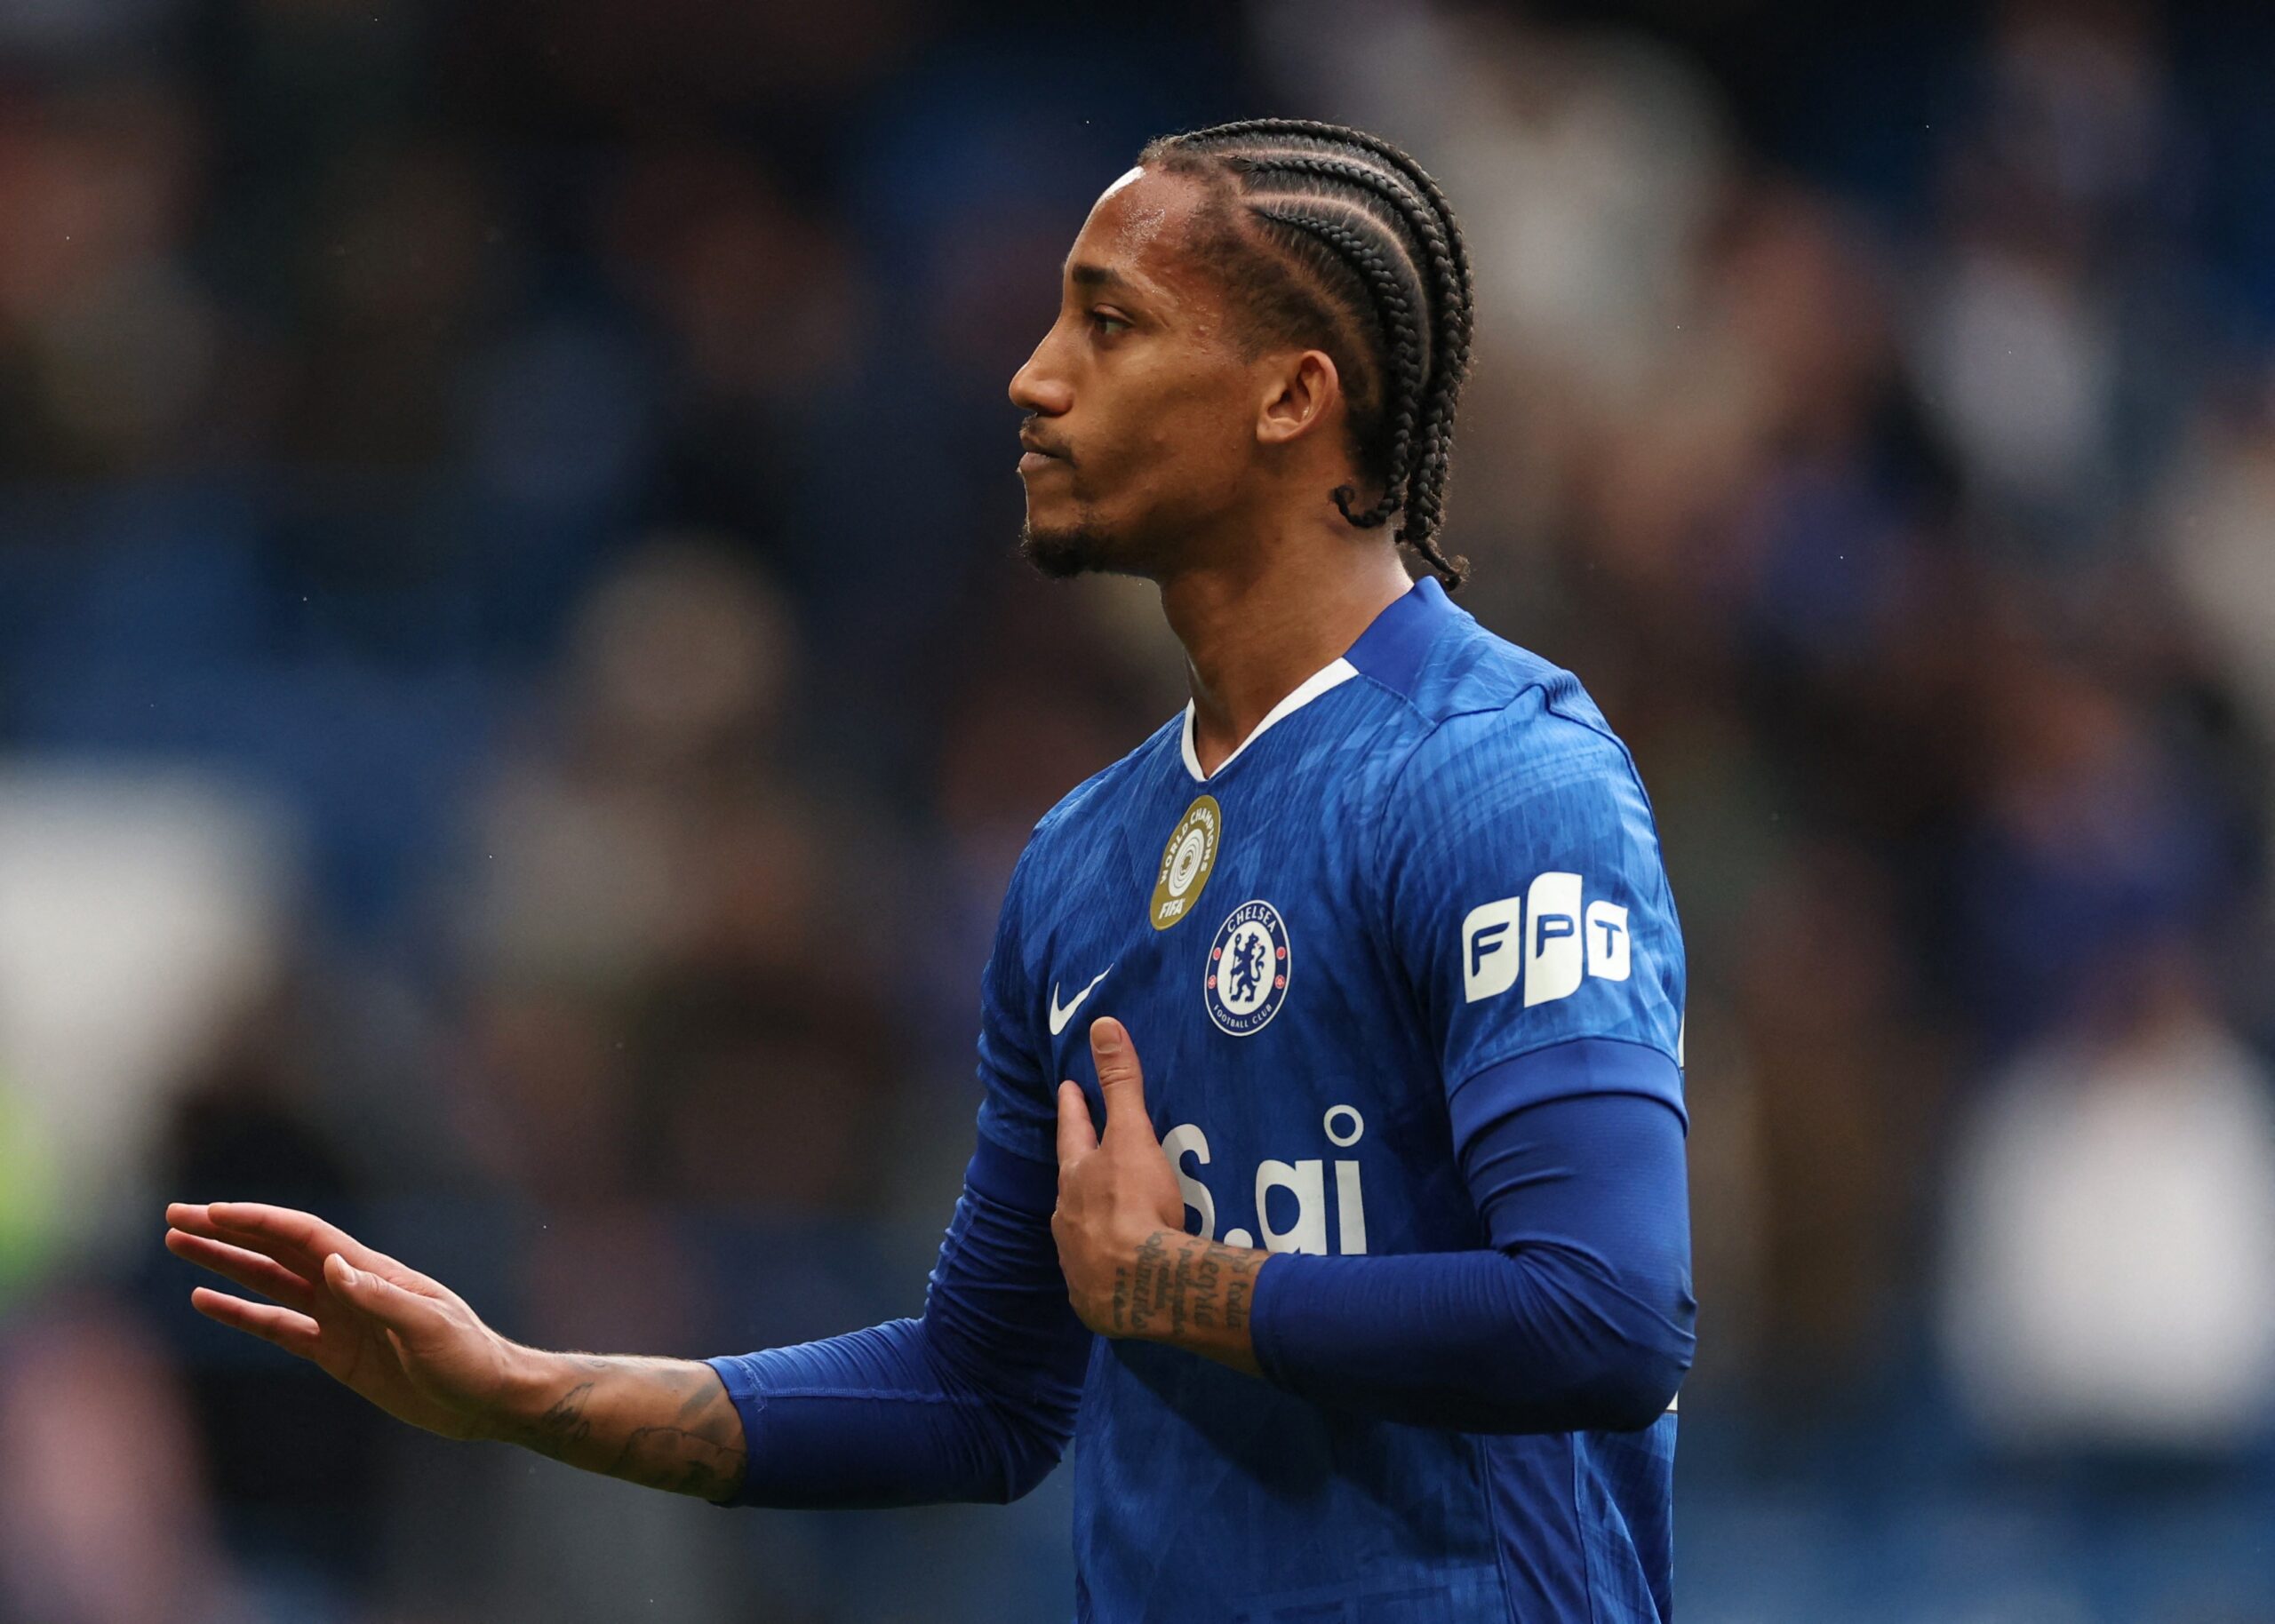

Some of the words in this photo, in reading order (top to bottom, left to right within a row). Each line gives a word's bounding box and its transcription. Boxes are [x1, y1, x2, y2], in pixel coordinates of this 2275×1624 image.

[1160, 823, 1188, 884] WORLD
[1190, 808, 1215, 872] CHAMPIONS
[1159, 898, 1185, 919] FIFA
[1227, 905, 1277, 933] CHELSEA
[1471, 913, 1623, 977] FPT
[1213, 1004, 1249, 1028] FOOTBALL
[1252, 1004, 1273, 1024] CLUB
